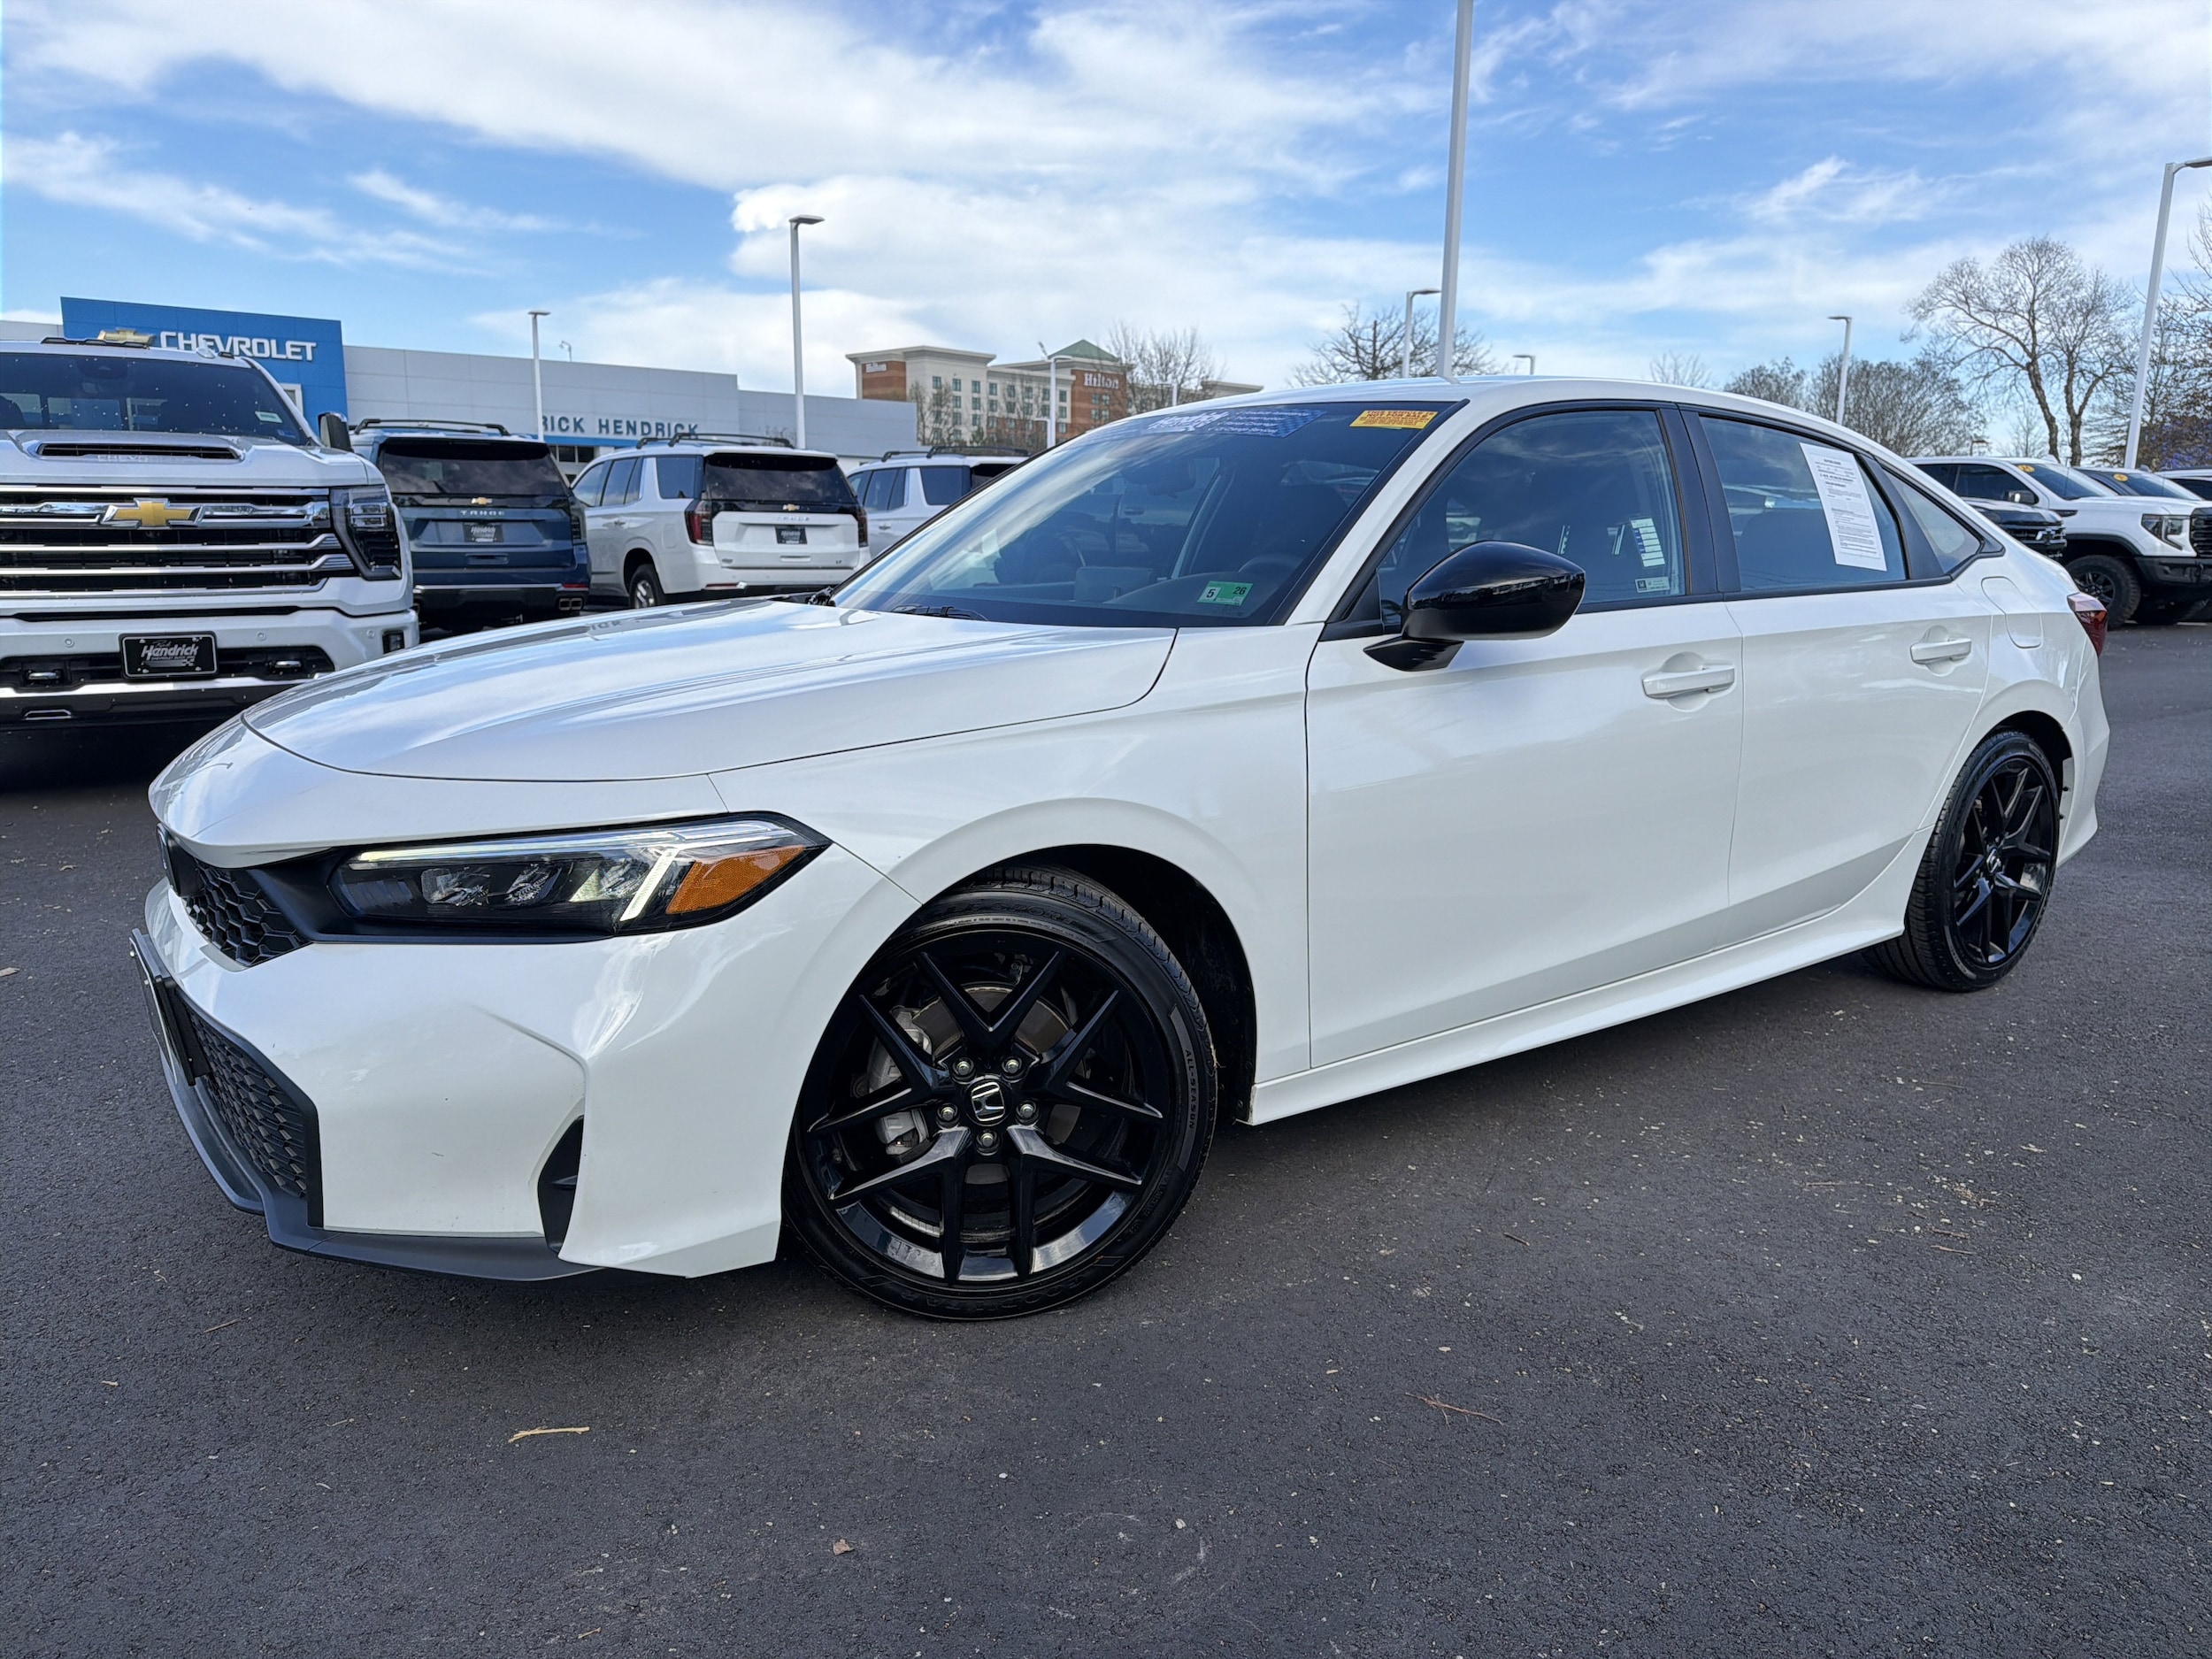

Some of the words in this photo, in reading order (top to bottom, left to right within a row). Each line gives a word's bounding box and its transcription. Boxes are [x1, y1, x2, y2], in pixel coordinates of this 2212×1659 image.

[160, 331, 317, 361] CHEVROLET
[1084, 373, 1119, 389] Hilton
[541, 416, 585, 433] RICK
[598, 419, 698, 439] HENDRICK
[1206, 588, 1217, 598] 5
[1233, 586, 1248, 595] 26
[141, 643, 199, 661] Hendrick
[1185, 1049, 1197, 1129] ALL-SEASON
